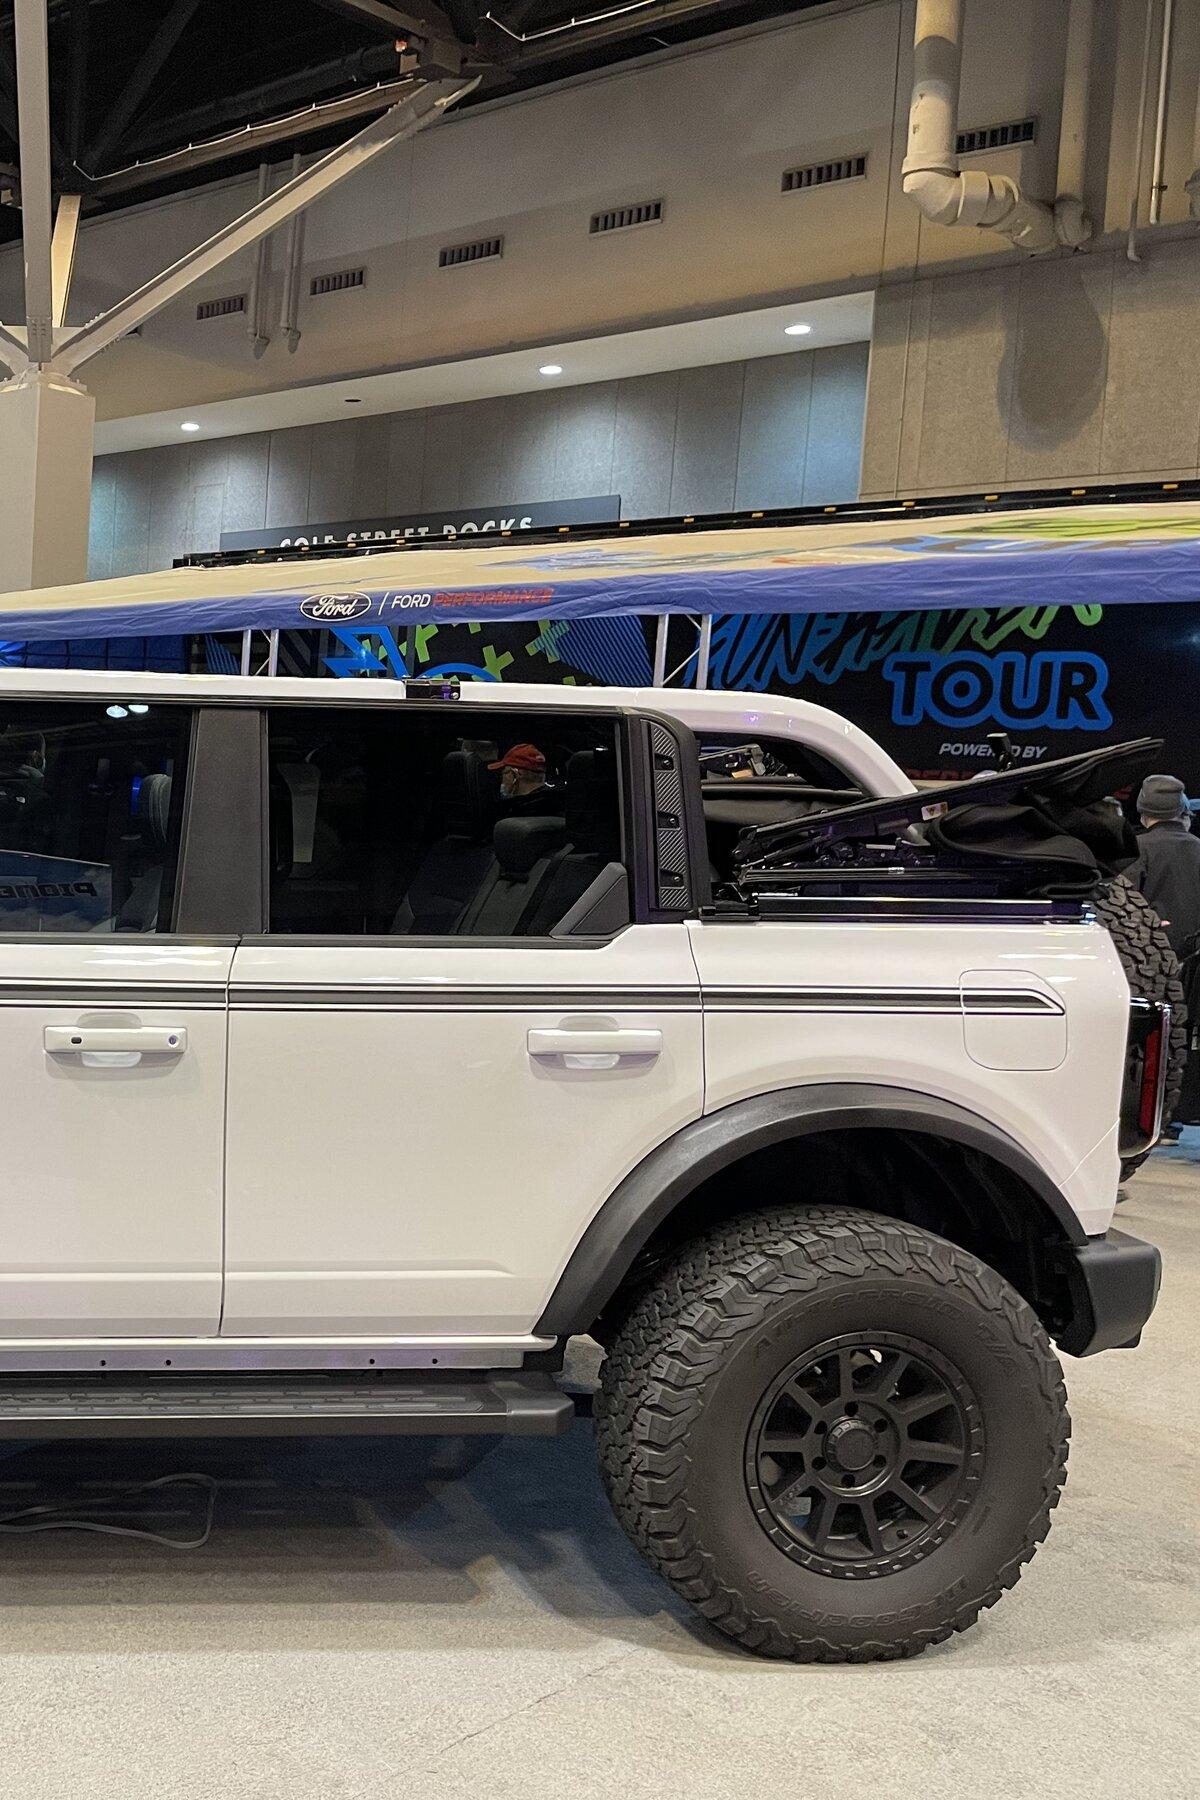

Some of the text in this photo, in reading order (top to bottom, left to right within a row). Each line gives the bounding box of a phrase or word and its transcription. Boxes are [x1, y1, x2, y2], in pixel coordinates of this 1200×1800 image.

[312, 594, 357, 616] Ford
[391, 594, 431, 609] FORD
[886, 656, 1107, 725] TOUR
[939, 743, 1048, 758] POWED BY
